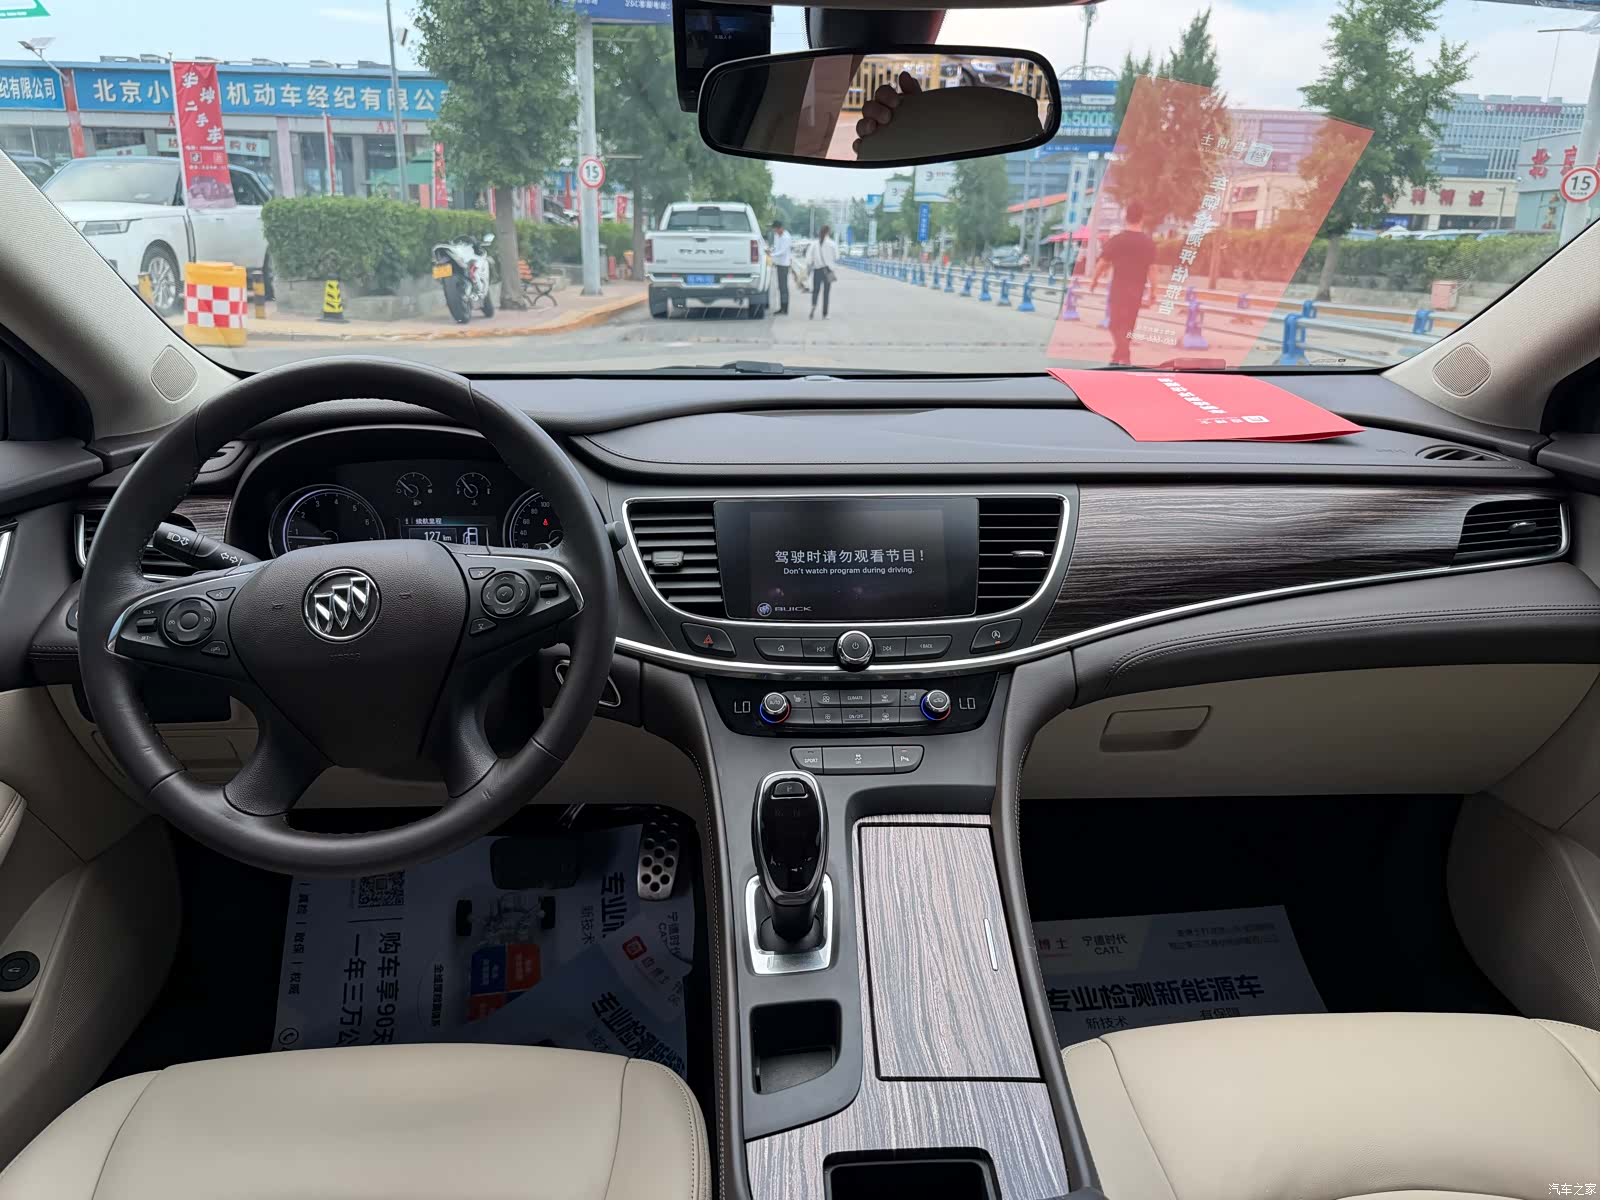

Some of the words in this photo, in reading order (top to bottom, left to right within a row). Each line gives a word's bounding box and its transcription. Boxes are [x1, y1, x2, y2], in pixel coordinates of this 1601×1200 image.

[0, 76, 56, 101] 纪有限公司
[92, 78, 450, 112] 北京小机动车经纪有限公
[585, 165, 600, 180] 15
[1570, 175, 1592, 191] 15
[415, 517, 442, 525] 续航里程
[424, 531, 441, 541] 127
[783, 567, 804, 575] Don't
[805, 567, 828, 575] watch
[830, 568, 861, 576] program
[862, 566, 886, 575] during
[887, 566, 915, 574] driving.
[734, 701, 751, 713] LO
[959, 697, 976, 710] LO
[657, 922, 669, 947] CAT
[1081, 933, 1129, 947] 宁德时代
[1094, 946, 1125, 955] CATL
[336, 933, 367, 1045] 一年三万公
[370, 931, 402, 1045] 购车享90天
[1046, 975, 1265, 1013] 专业检测新能源车
[1085, 1015, 1129, 1030] 新技术
